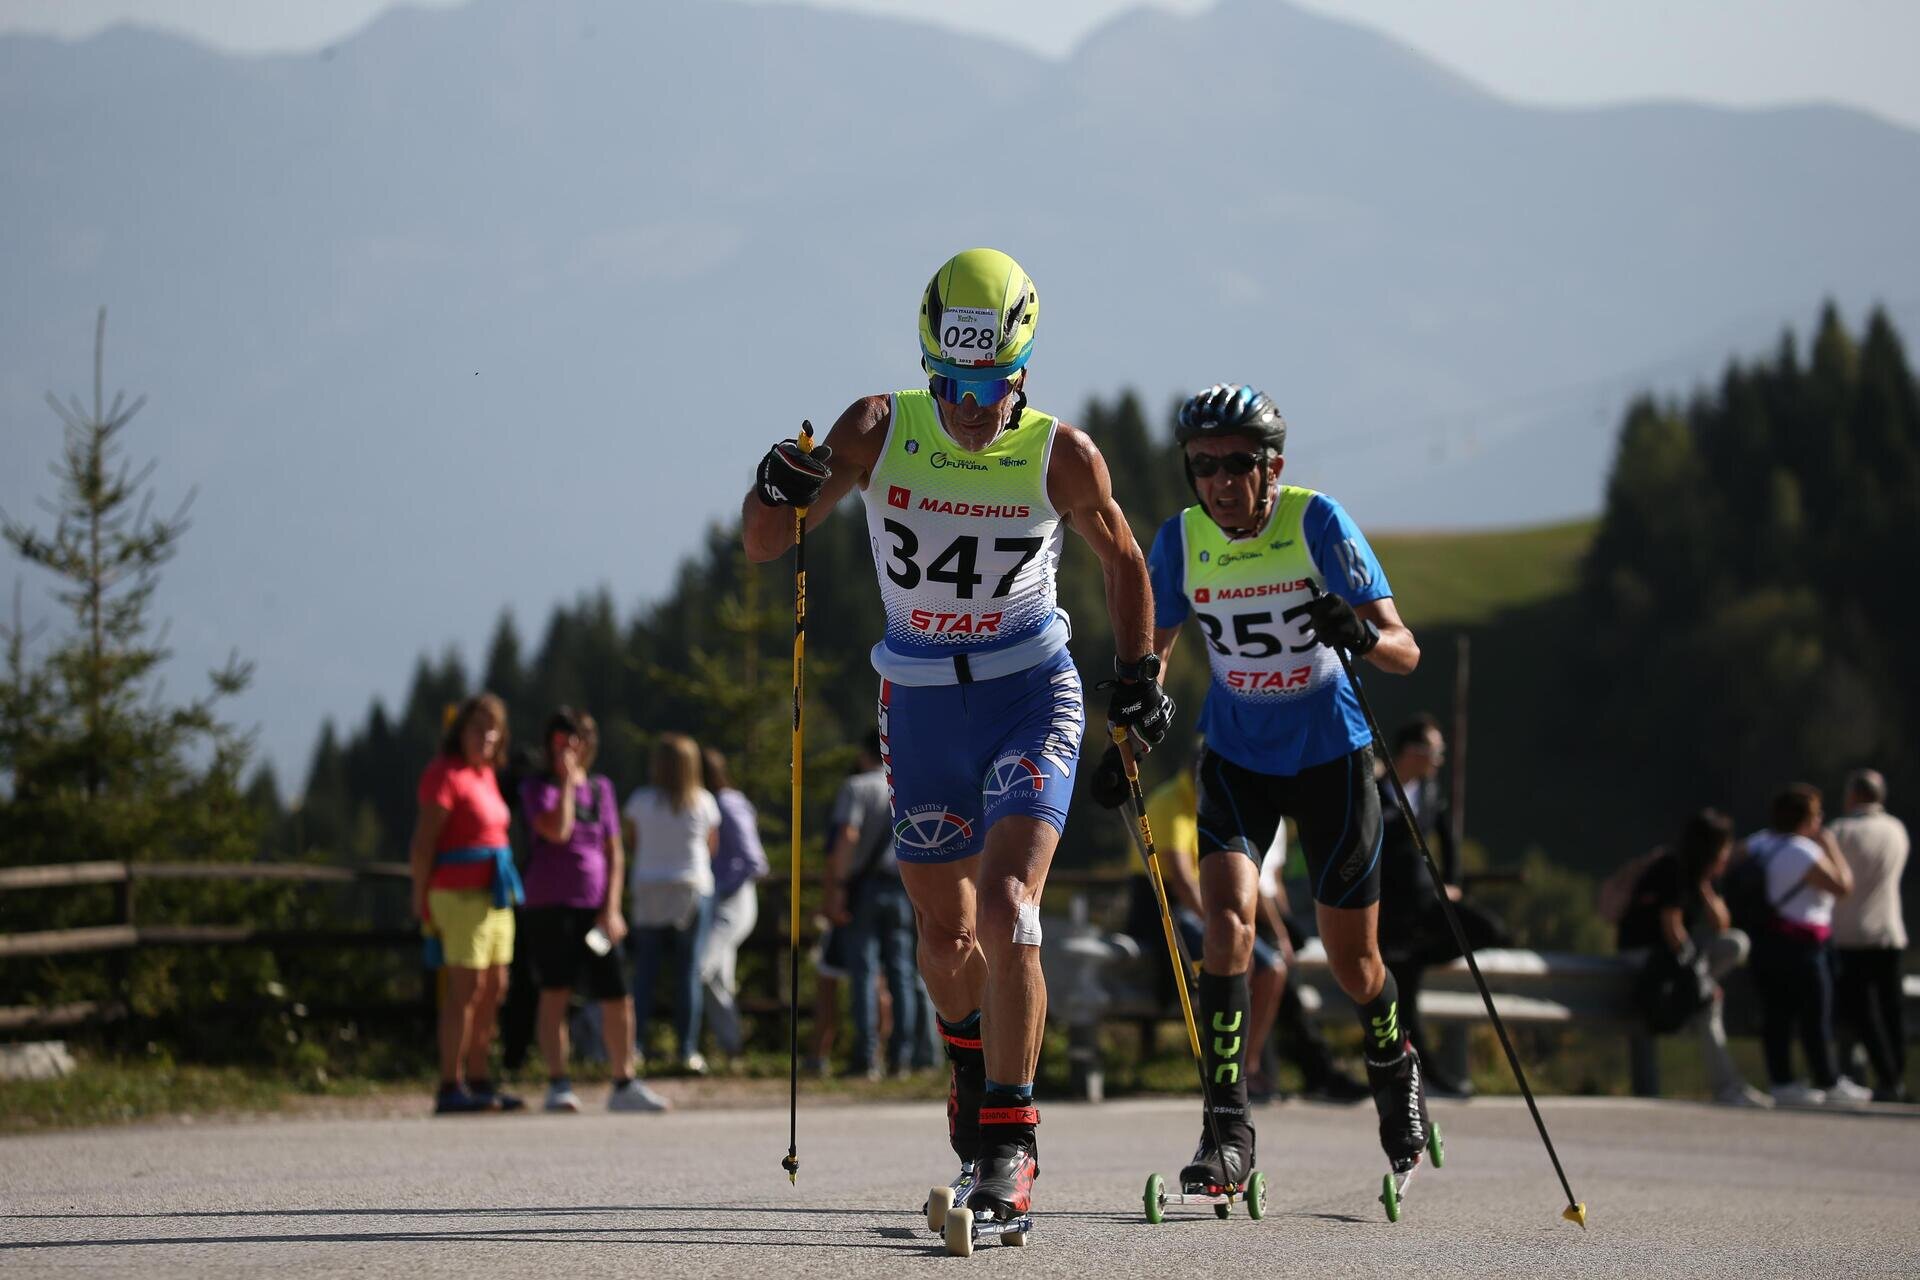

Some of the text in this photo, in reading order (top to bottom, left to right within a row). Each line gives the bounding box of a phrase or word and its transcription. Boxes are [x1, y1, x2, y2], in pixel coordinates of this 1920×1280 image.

[944, 326, 995, 350] 028
[946, 462, 989, 471] FUTURA
[918, 497, 1030, 518] MADSHUS
[883, 517, 1045, 600] 347
[1217, 579, 1309, 600] MADSHUS
[910, 608, 1003, 633] STAR
[1227, 665, 1312, 689] STAR
[911, 803, 942, 815] aams
